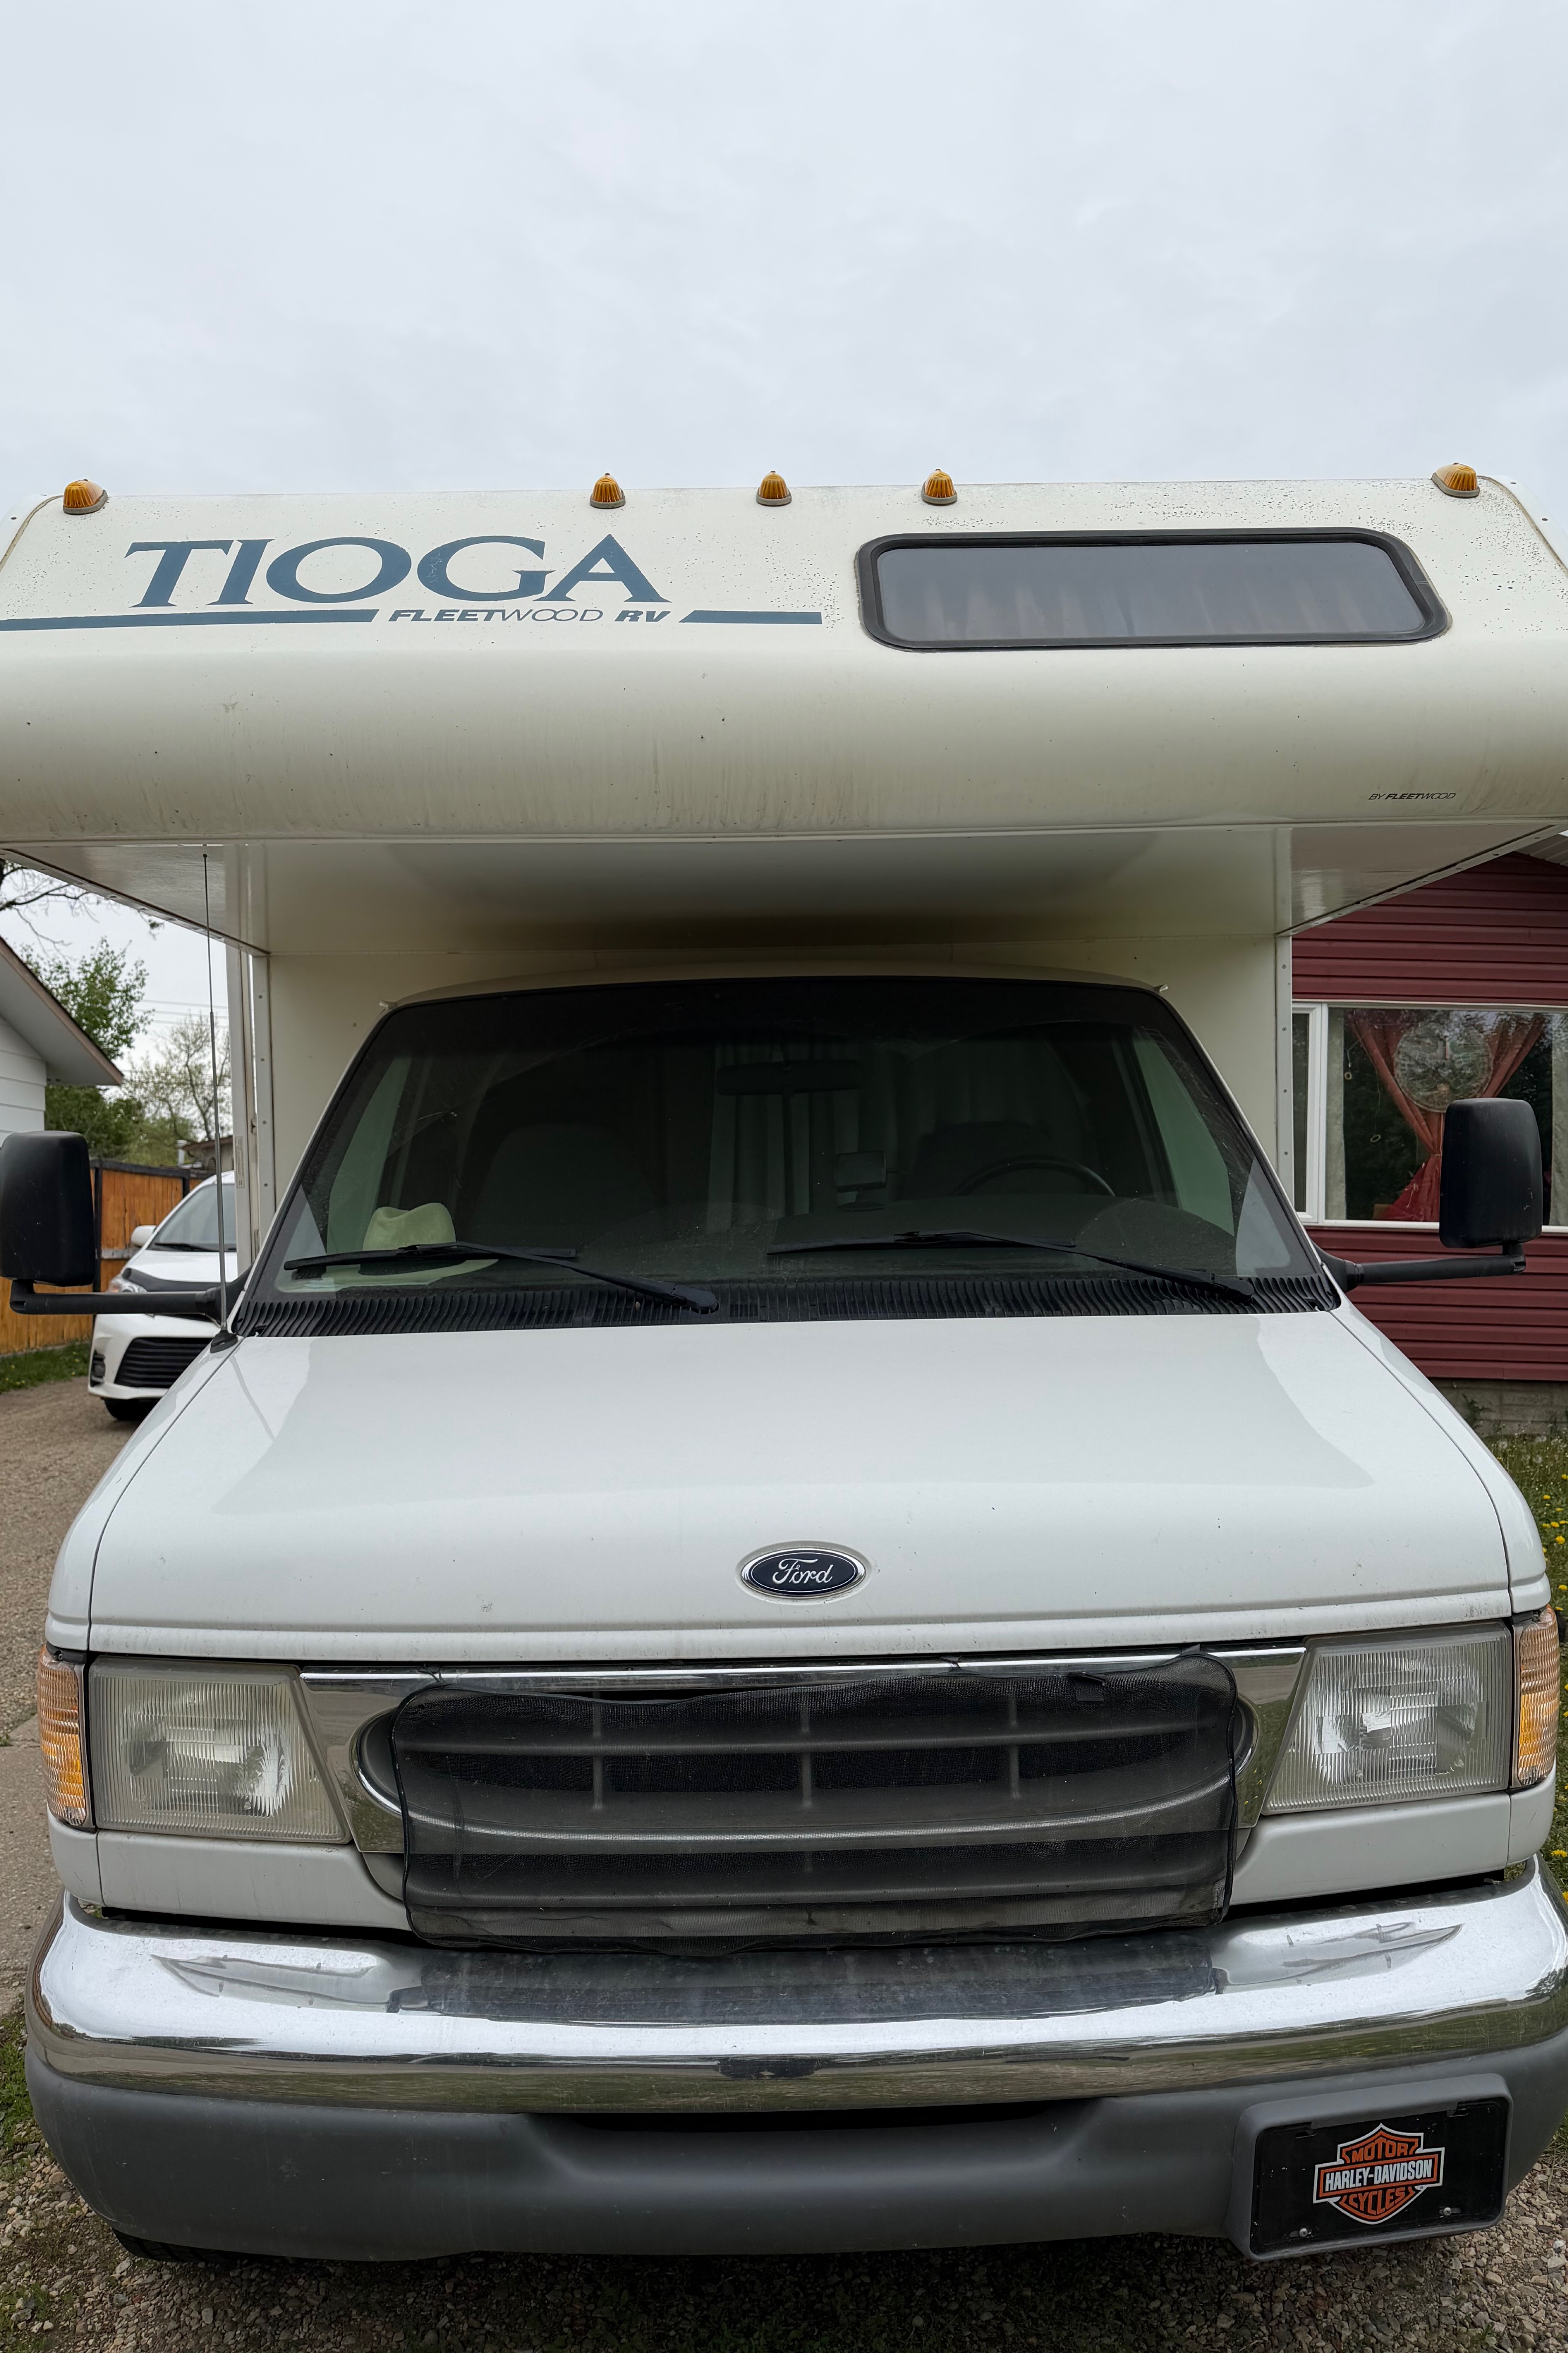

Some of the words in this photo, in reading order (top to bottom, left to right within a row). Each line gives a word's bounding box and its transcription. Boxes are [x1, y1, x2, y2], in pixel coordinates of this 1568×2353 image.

[124, 534, 672, 608] TIOGA
[389, 609, 603, 621] FLEETWOOD
[615, 610, 671, 622] RV
[773, 1558, 834, 1584] Ford
[1352, 2137, 1408, 2163] MOTOR
[1325, 2159, 1433, 2192] HARLEY-DAVIDSON
[1349, 2187, 1405, 2215] CYCLES
